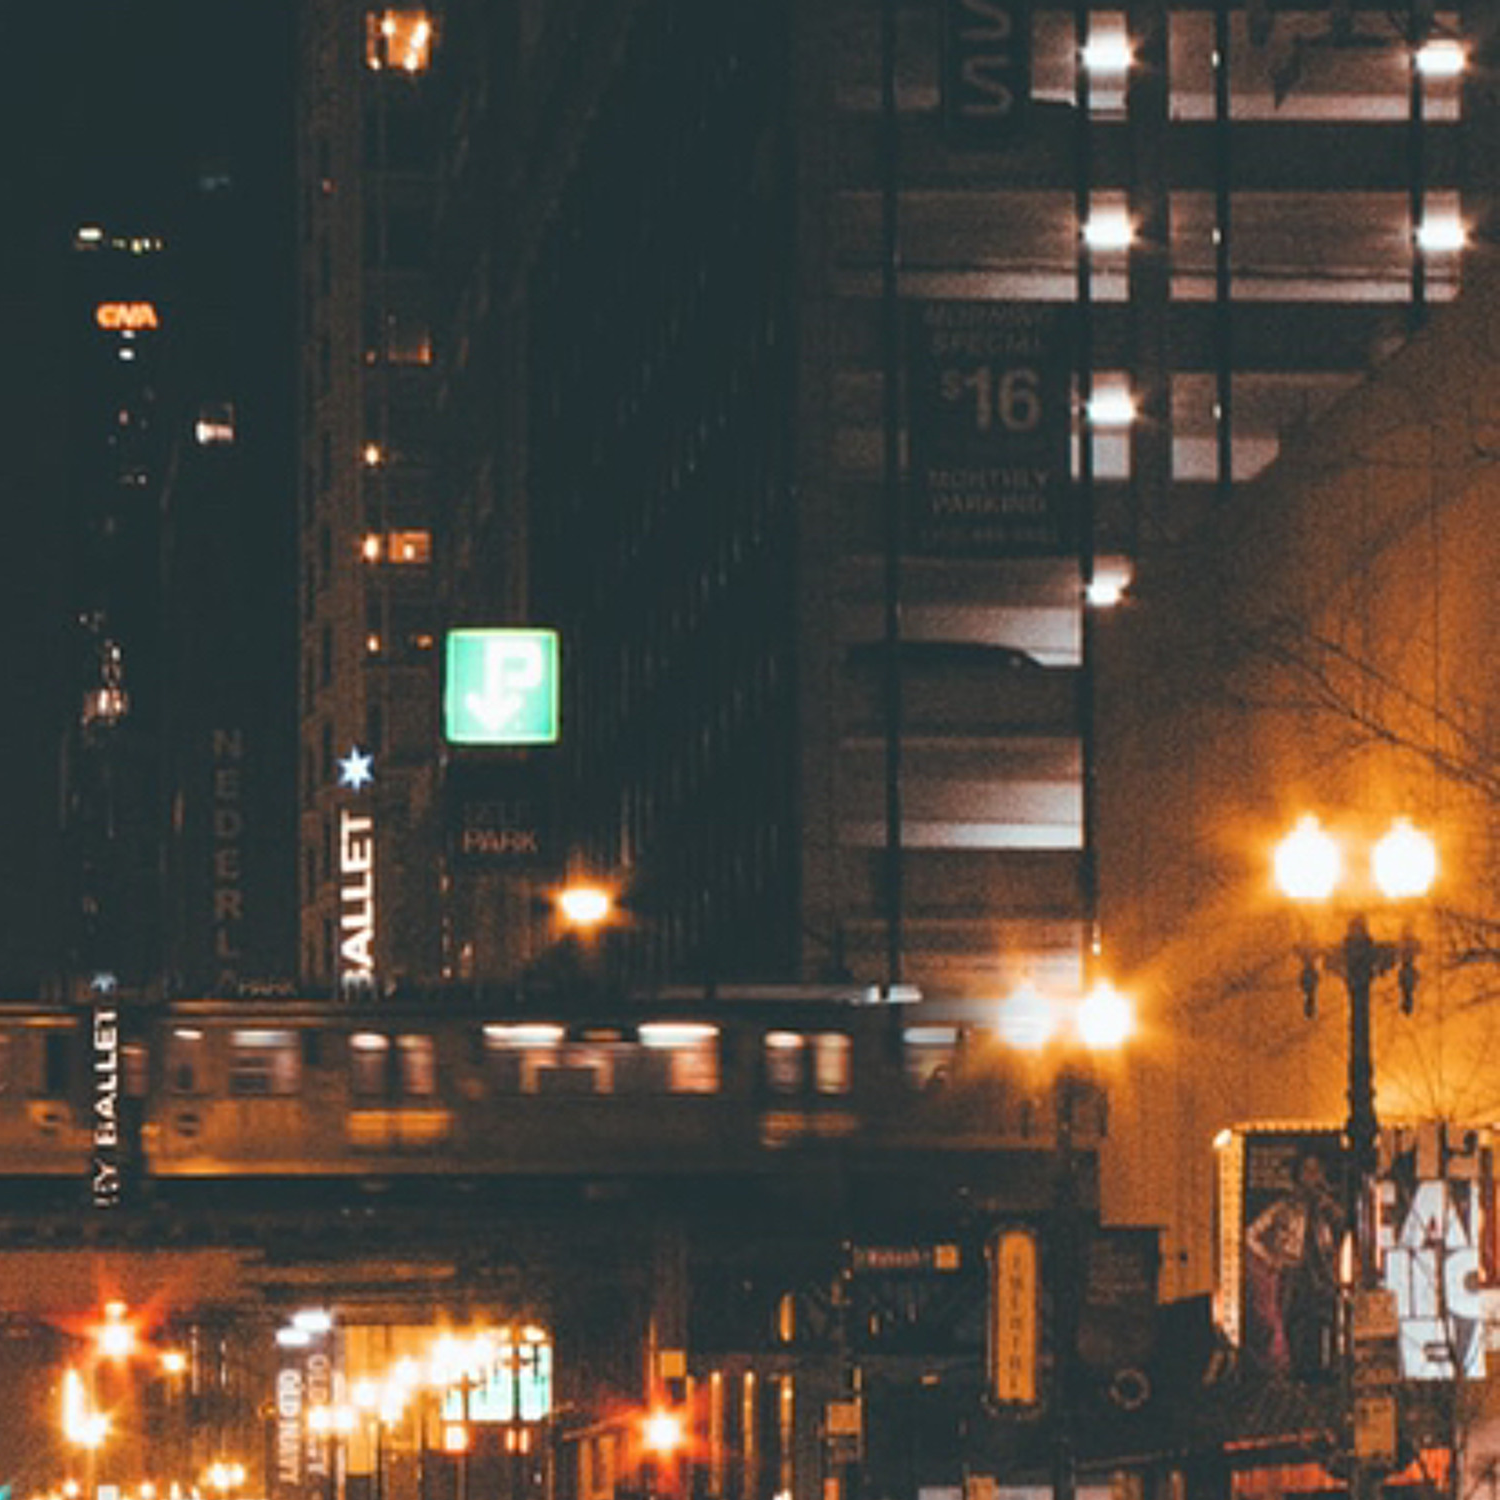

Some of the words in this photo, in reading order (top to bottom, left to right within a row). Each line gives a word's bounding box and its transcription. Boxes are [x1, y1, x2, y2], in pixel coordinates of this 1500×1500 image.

[96, 302, 158, 329] CNA
[940, 364, 1043, 432] $16
[931, 493, 1048, 515] PARKING
[463, 828, 538, 854] PARK
[93, 1008, 119, 1146] BALLET
